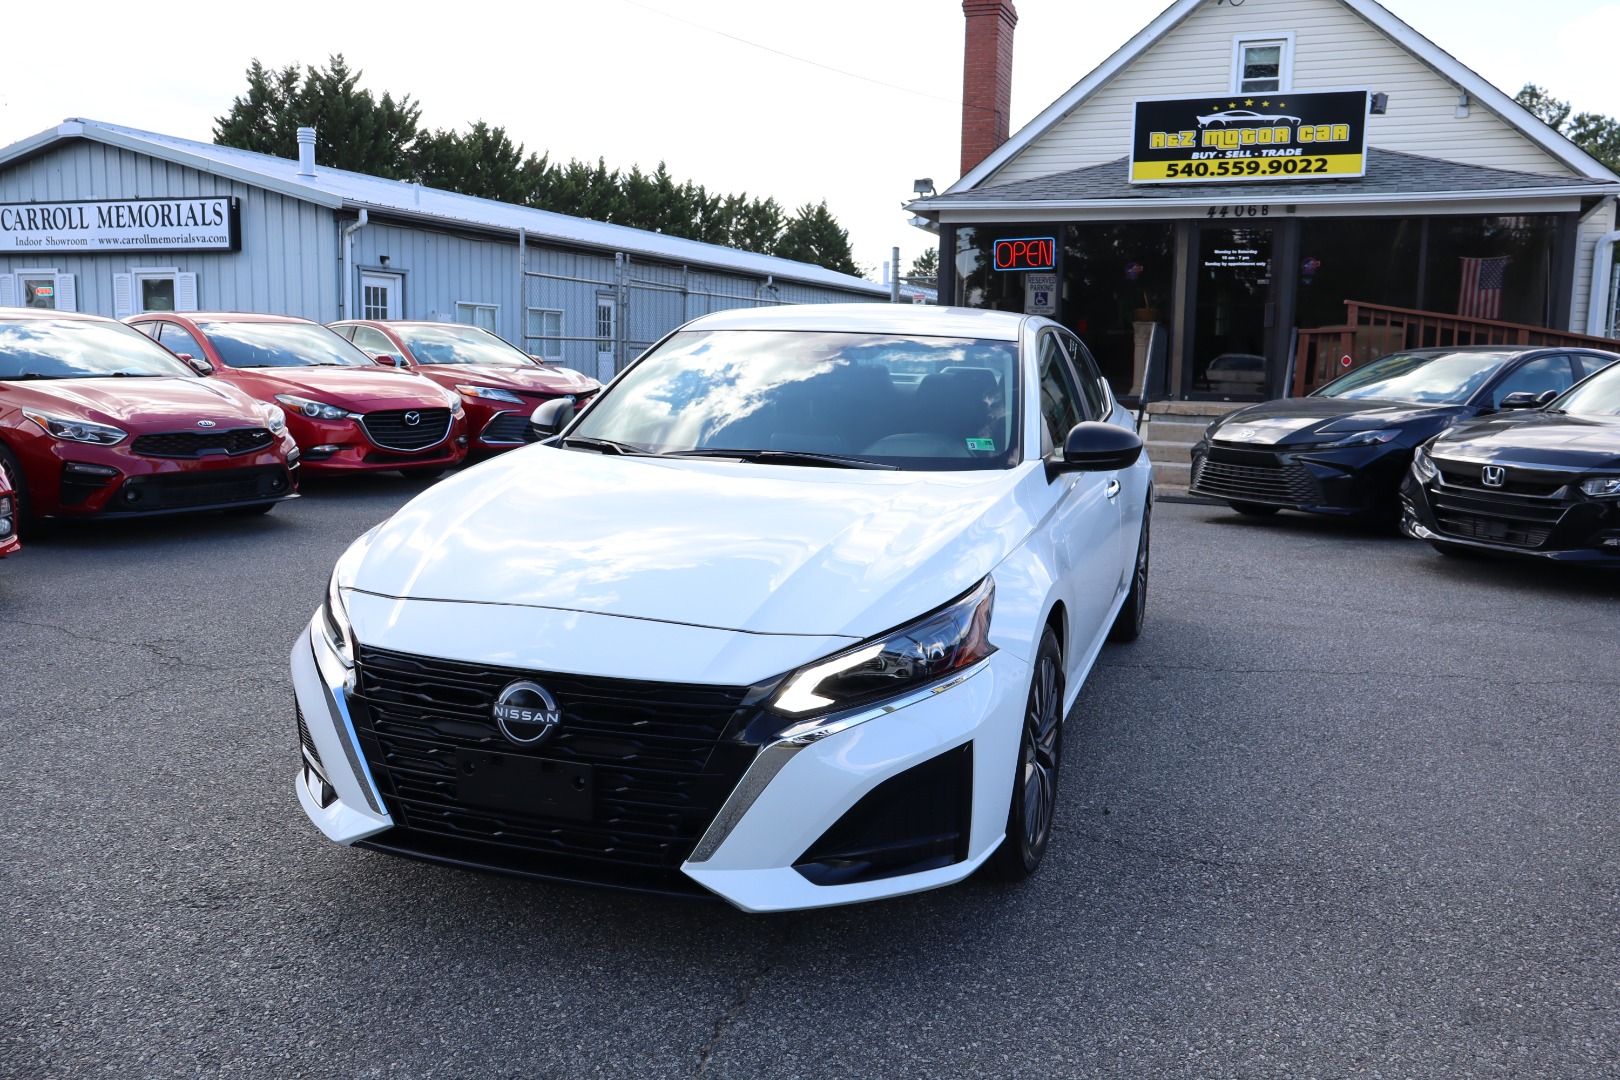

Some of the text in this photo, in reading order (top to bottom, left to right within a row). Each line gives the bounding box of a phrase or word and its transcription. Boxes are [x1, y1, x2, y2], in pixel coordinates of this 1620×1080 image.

[1191, 148, 1303, 159] BUY SELL TRADE
[1166, 158, 1328, 177] 540.559.9022
[1, 202, 223, 231] CARROLL MEMORIALS
[15, 236, 42, 246] Indoor
[45, 236, 88, 246] Showroom
[98, 233, 227, 245] www.carrollmemorialsva.com
[997, 240, 1052, 267] OPEN
[1028, 276, 1056, 284] RESERVED
[1030, 284, 1053, 292] PARKING
[494, 705, 559, 723] NISSAN
